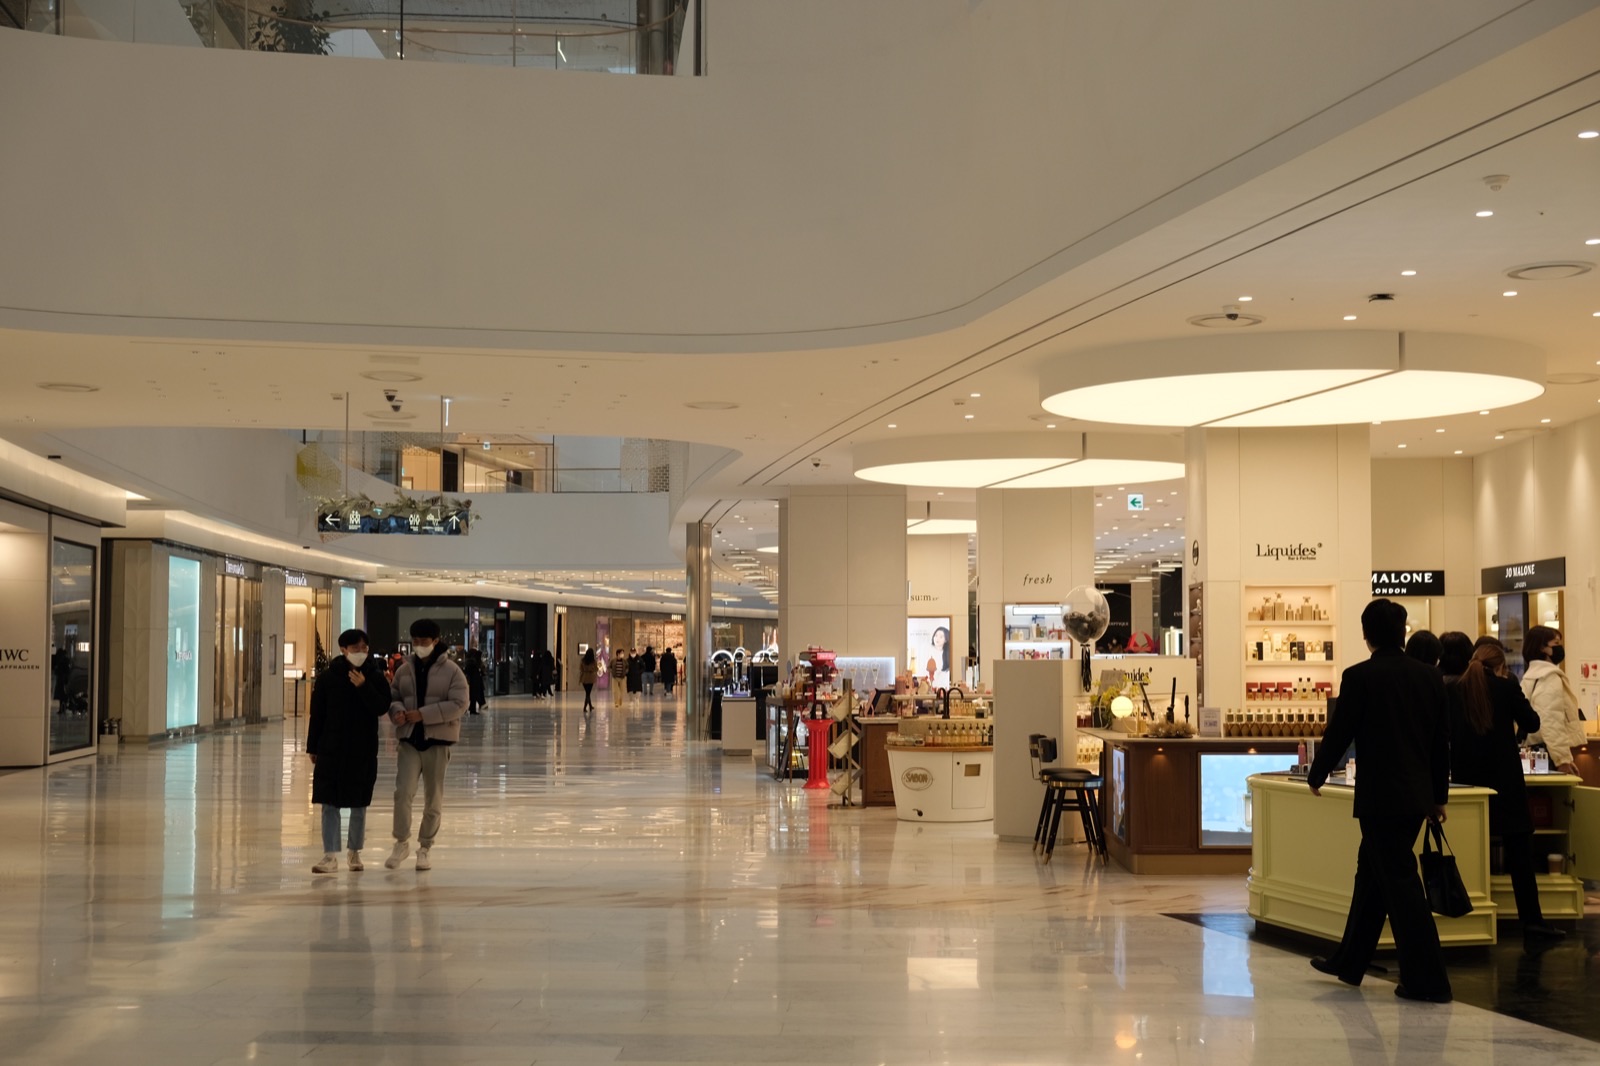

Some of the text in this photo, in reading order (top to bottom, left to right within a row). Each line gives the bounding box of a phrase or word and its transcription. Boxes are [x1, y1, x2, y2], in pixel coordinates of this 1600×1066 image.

[1505, 564, 1535, 578] JO MALONE
[1023, 573, 1053, 586] fresh
[905, 773, 928, 783] SABON
